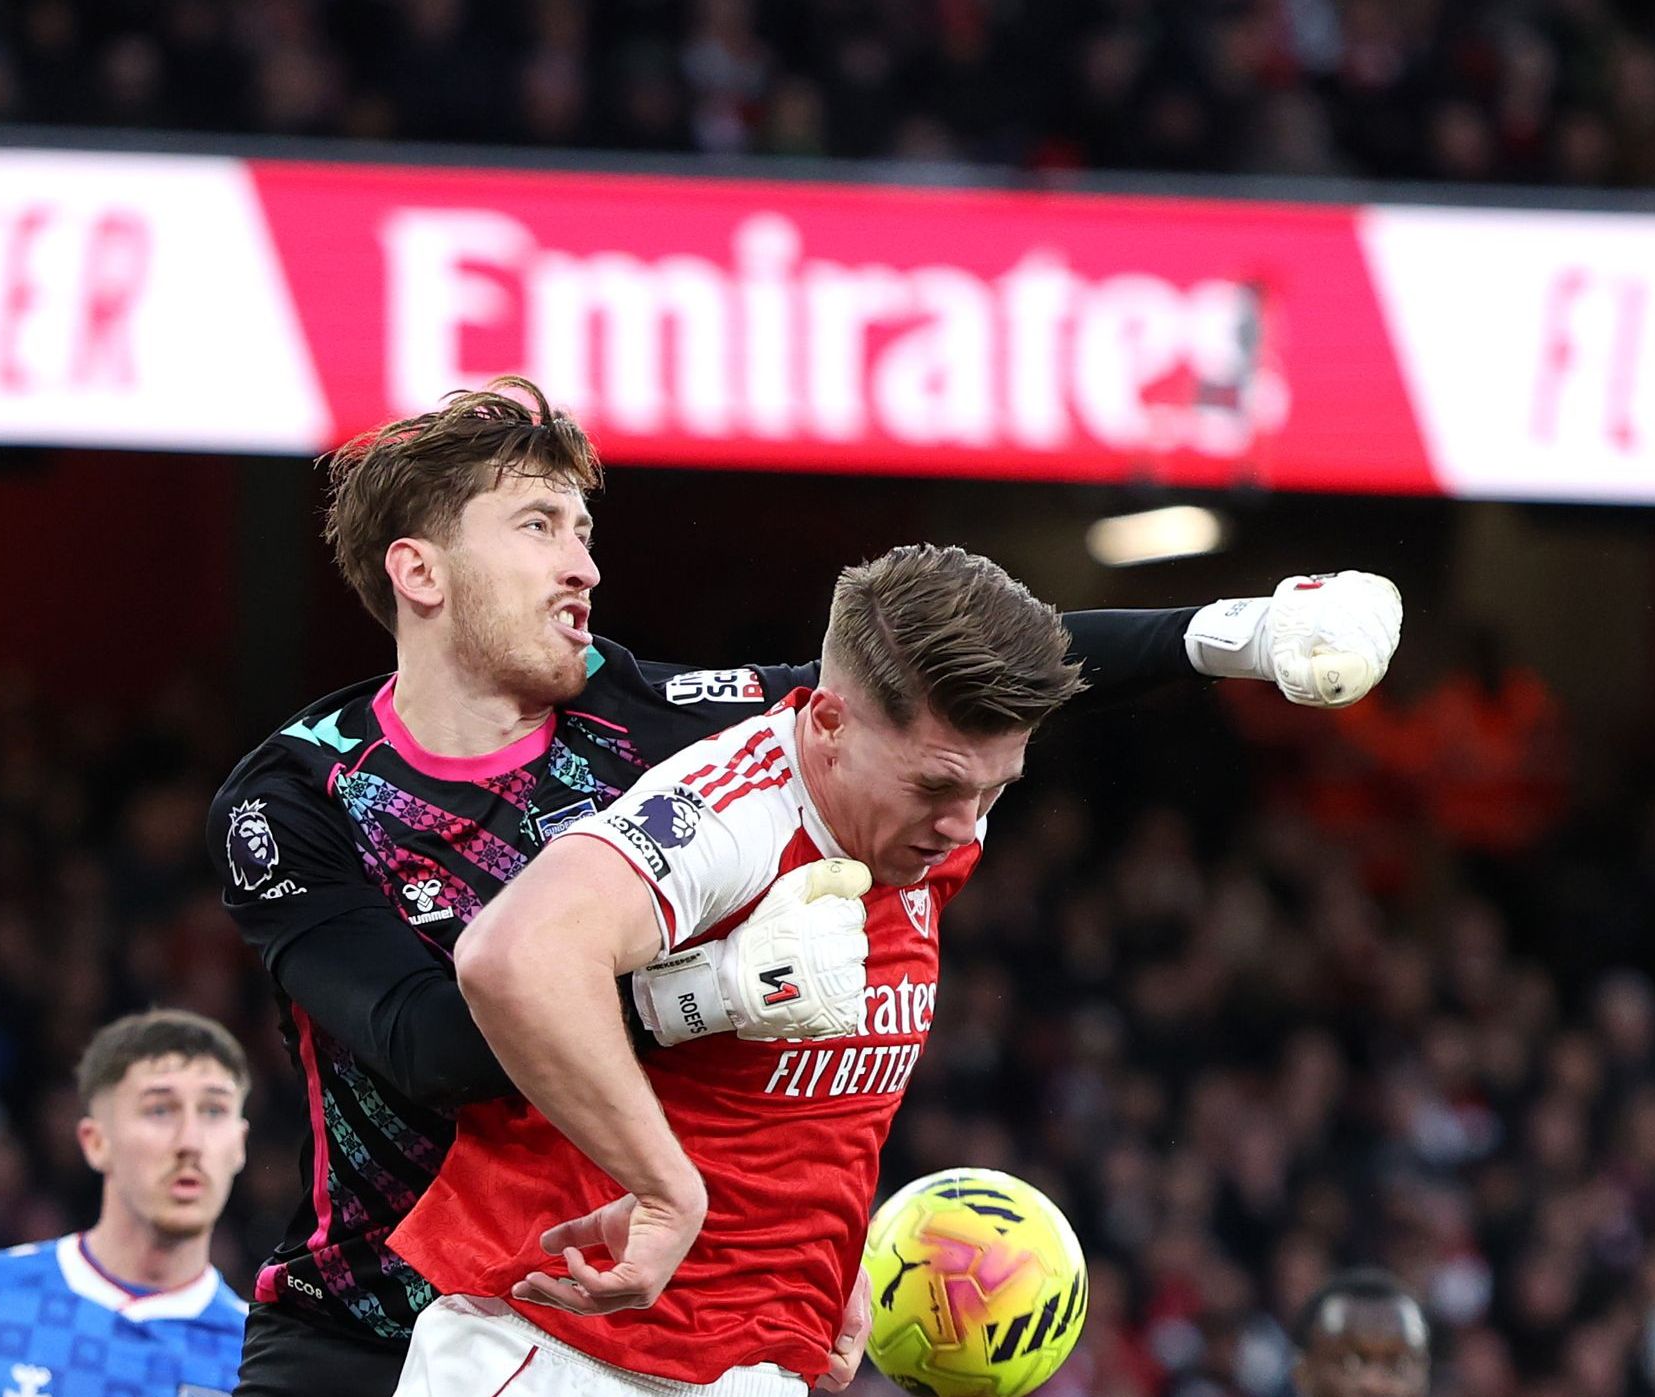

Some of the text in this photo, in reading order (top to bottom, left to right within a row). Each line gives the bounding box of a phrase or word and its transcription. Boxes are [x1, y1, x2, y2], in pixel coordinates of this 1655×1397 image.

[382, 208, 1290, 460] Emirates
[626, 826, 666, 875] room
[677, 991, 708, 1035] ROEFS
[763, 1043, 921, 1098] FLY BETTER
